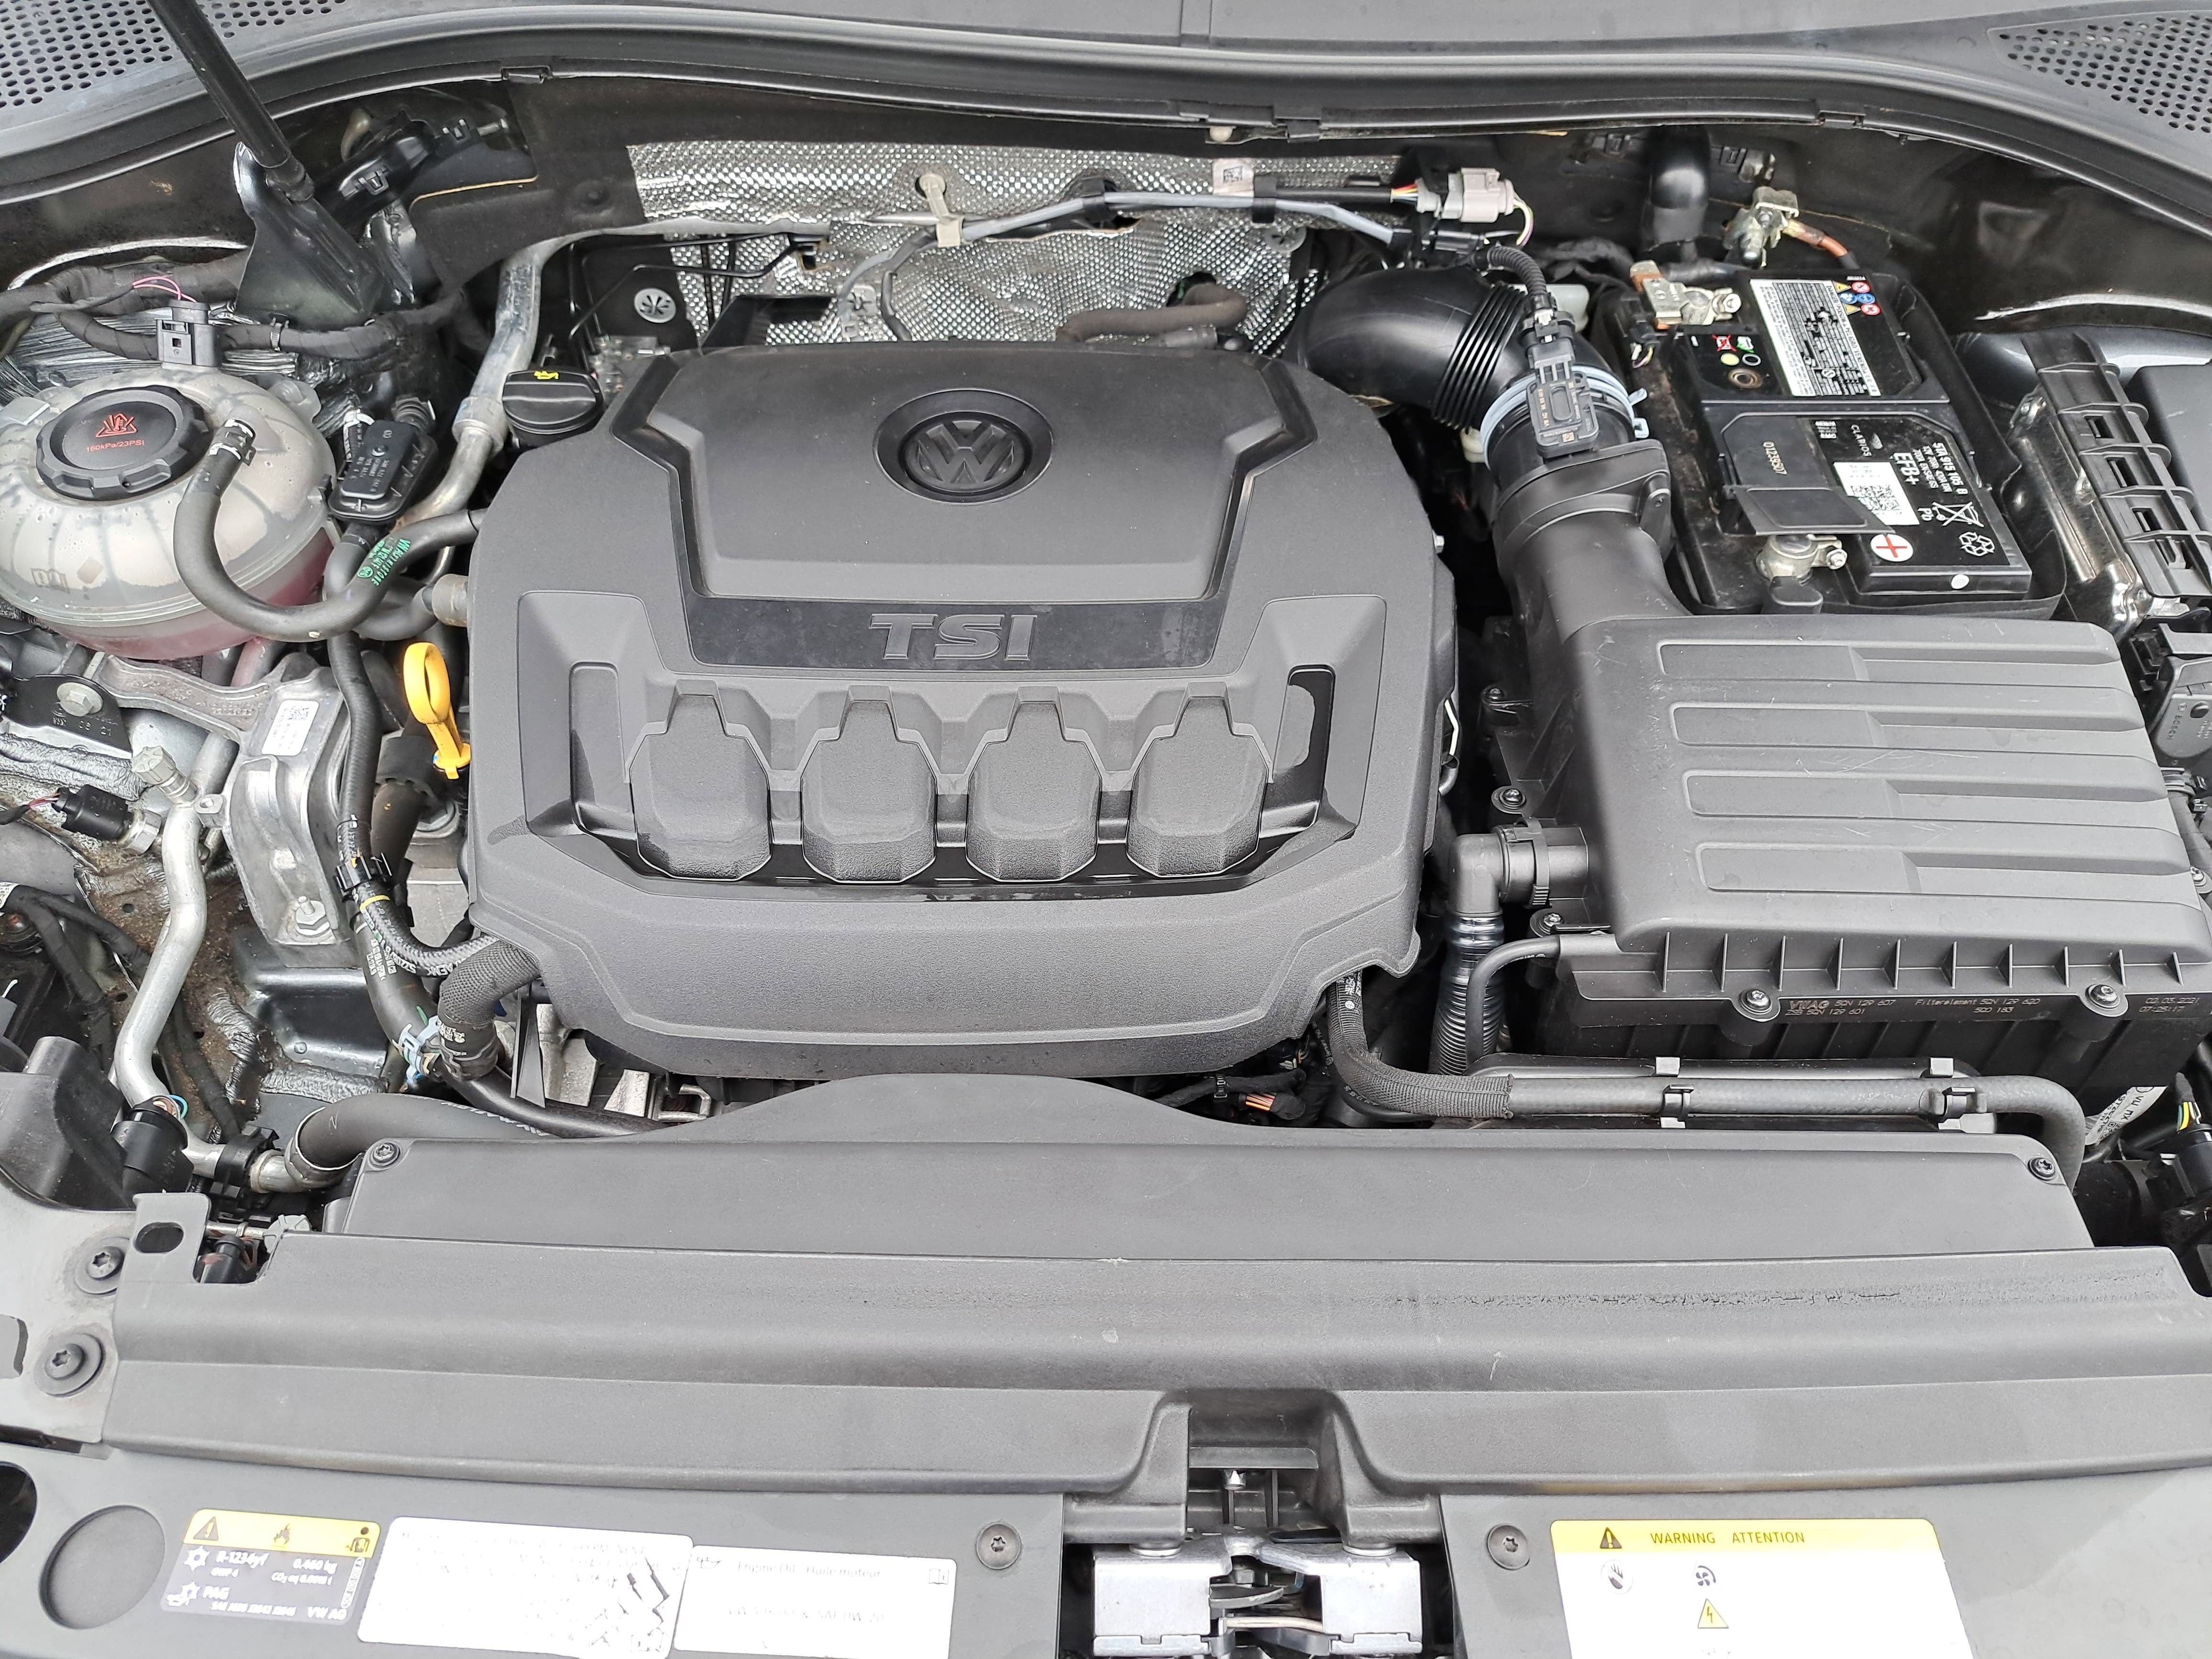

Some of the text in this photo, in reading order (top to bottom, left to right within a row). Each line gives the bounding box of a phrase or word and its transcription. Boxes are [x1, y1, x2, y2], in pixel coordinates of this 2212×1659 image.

[1851, 424, 1872, 456] CLARIOS
[1893, 453, 1920, 485] EFB+
[1940, 456, 1956, 471] 915
[1948, 472, 1964, 486] 105
[1918, 508, 1934, 521] Pb
[869, 614, 1037, 661] TSI
[1650, 1531, 1806, 1544] WARNING ATTENTION
[203, 1586, 230, 1600] PAG
[307, 1606, 329, 1619] VW
